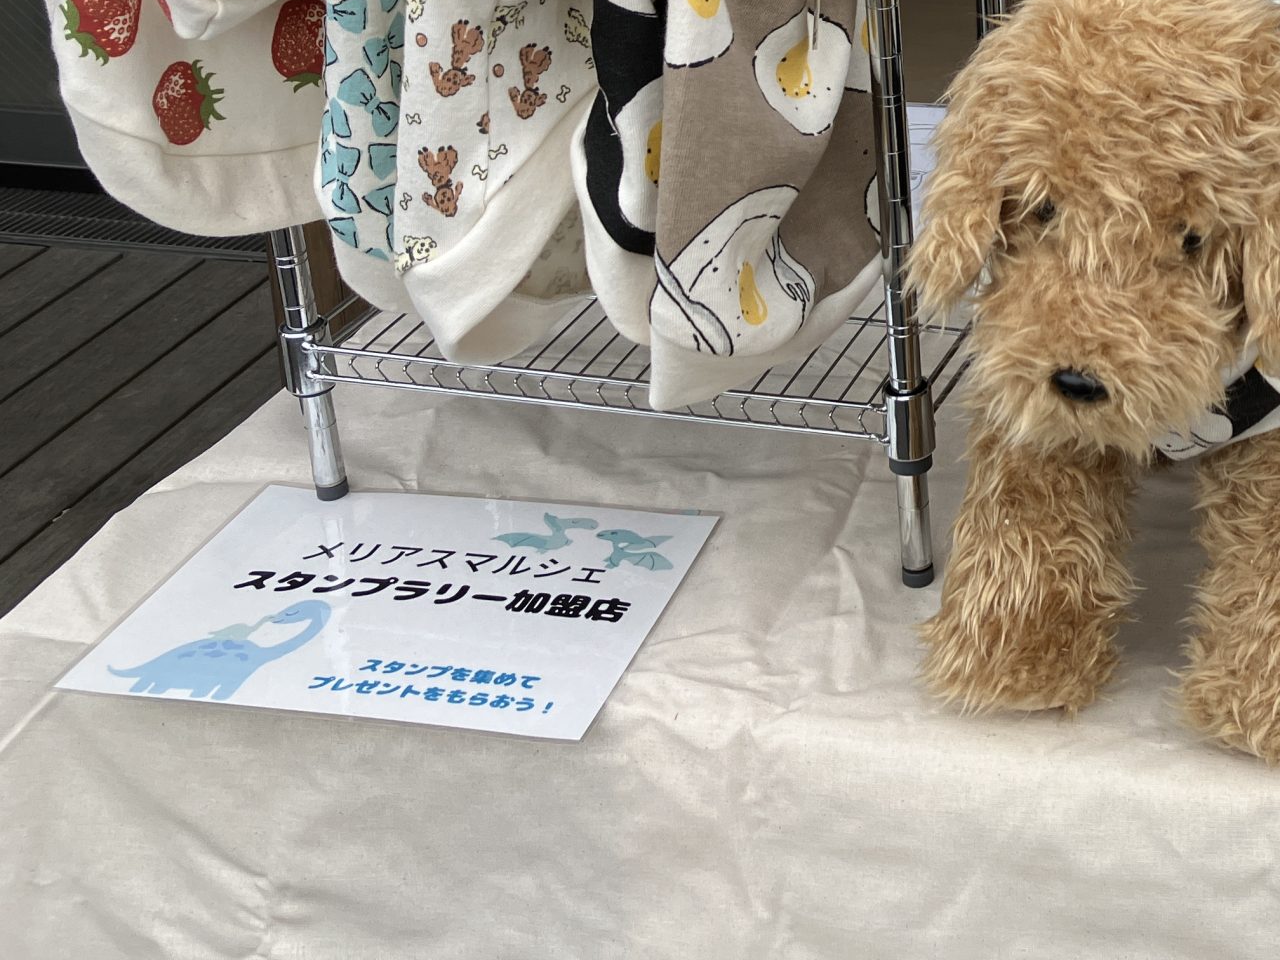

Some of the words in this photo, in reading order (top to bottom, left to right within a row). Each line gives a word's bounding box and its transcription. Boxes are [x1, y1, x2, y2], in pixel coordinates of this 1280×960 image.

[302, 538, 610, 585] メリアスマルシェ
[233, 570, 633, 625] スタンプラリー加盟店
[357, 658, 543, 691] スタンプを集めて
